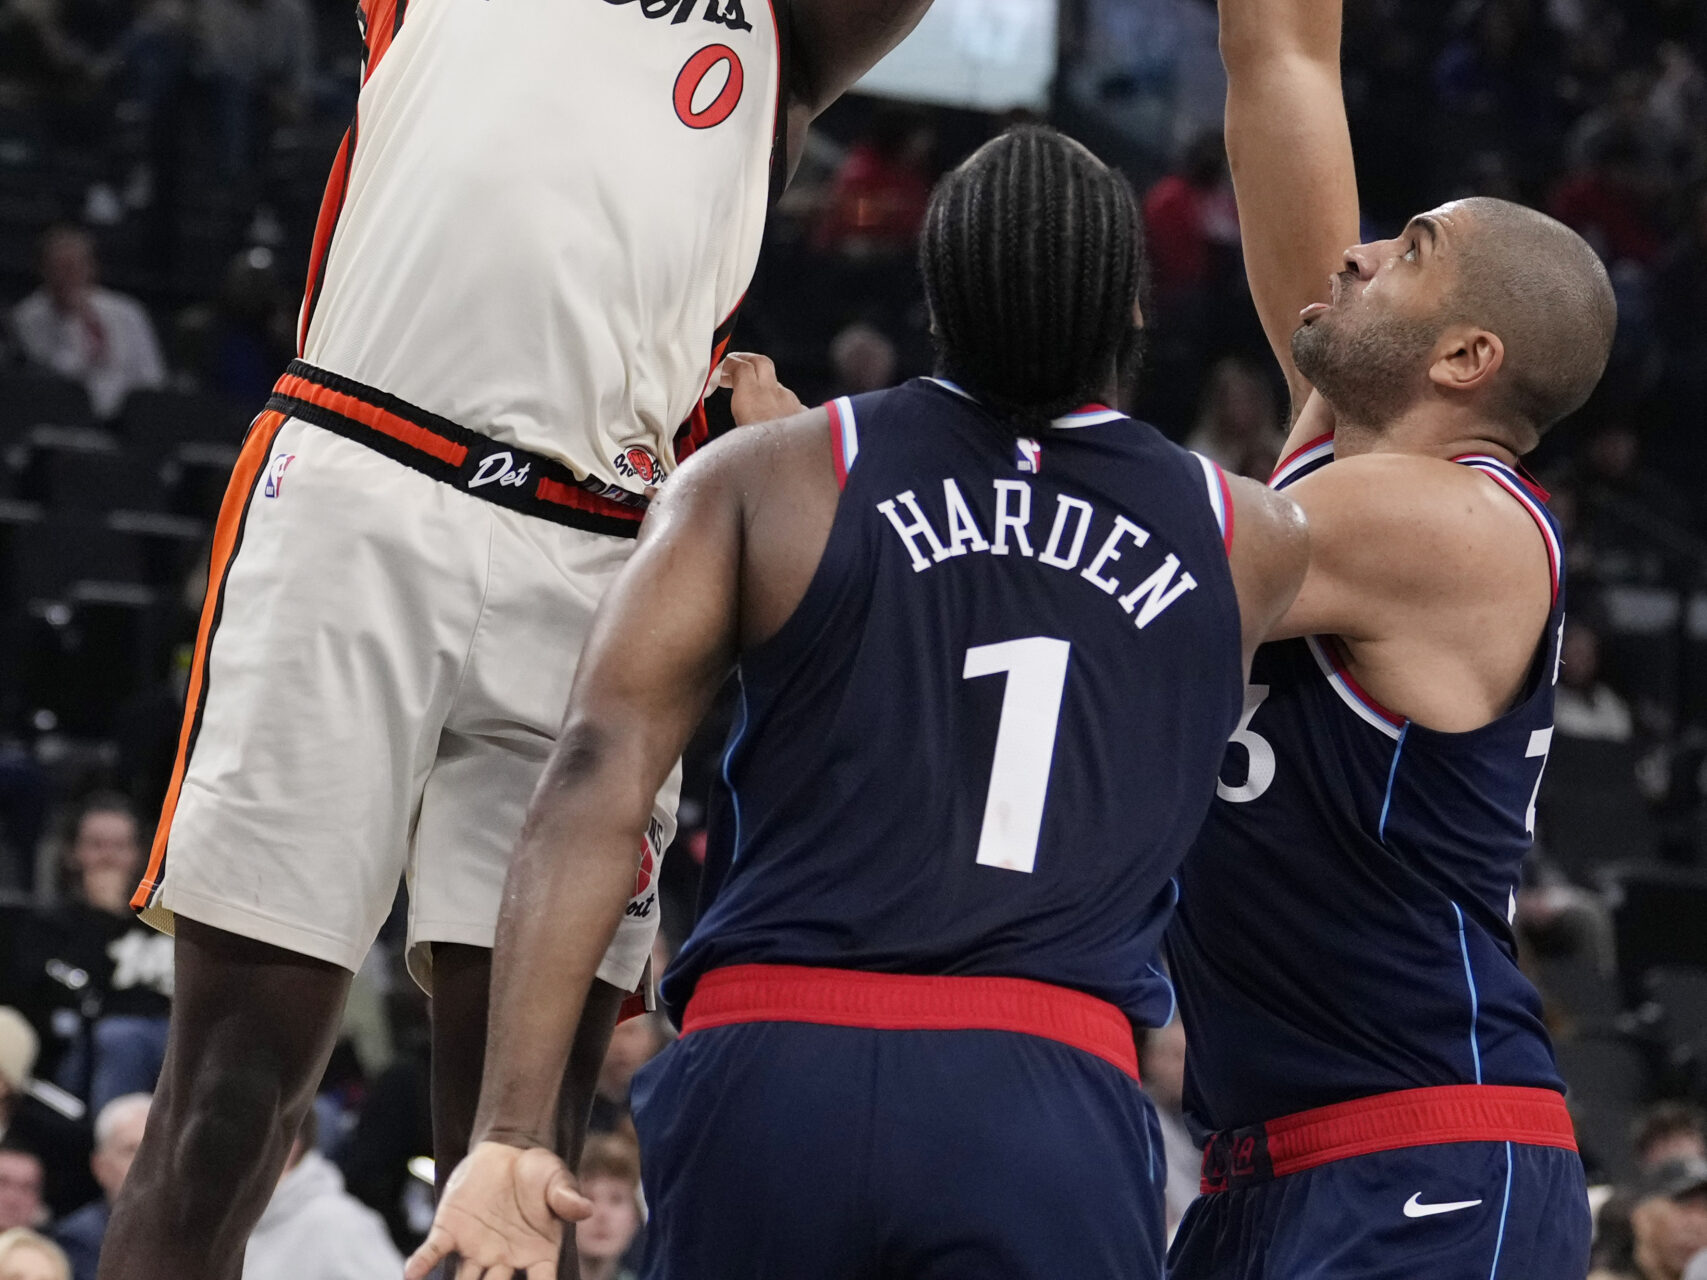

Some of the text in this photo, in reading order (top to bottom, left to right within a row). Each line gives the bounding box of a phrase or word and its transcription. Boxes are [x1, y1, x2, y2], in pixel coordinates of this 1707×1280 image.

[672, 43, 744, 130] 0
[468, 451, 531, 488] Det
[876, 477, 1198, 629] HARDEN
[963, 636, 1071, 874] 1
